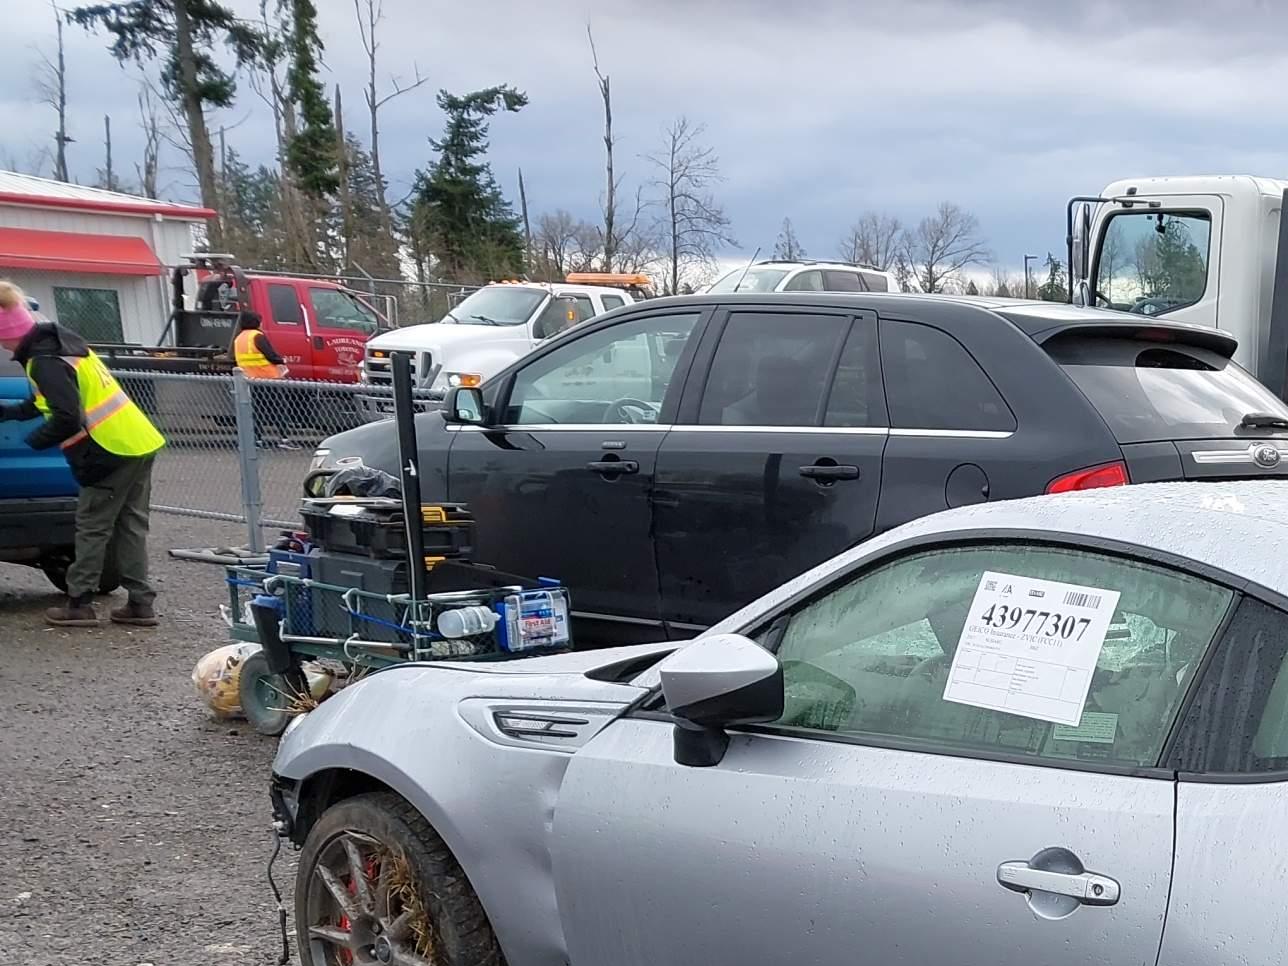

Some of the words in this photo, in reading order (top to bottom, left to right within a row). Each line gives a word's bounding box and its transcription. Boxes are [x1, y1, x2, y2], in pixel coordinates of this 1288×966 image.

[968, 625, 990, 635] GEICO
[990, 629, 1016, 639] Insurance
[981, 603, 1091, 641] 43977307
